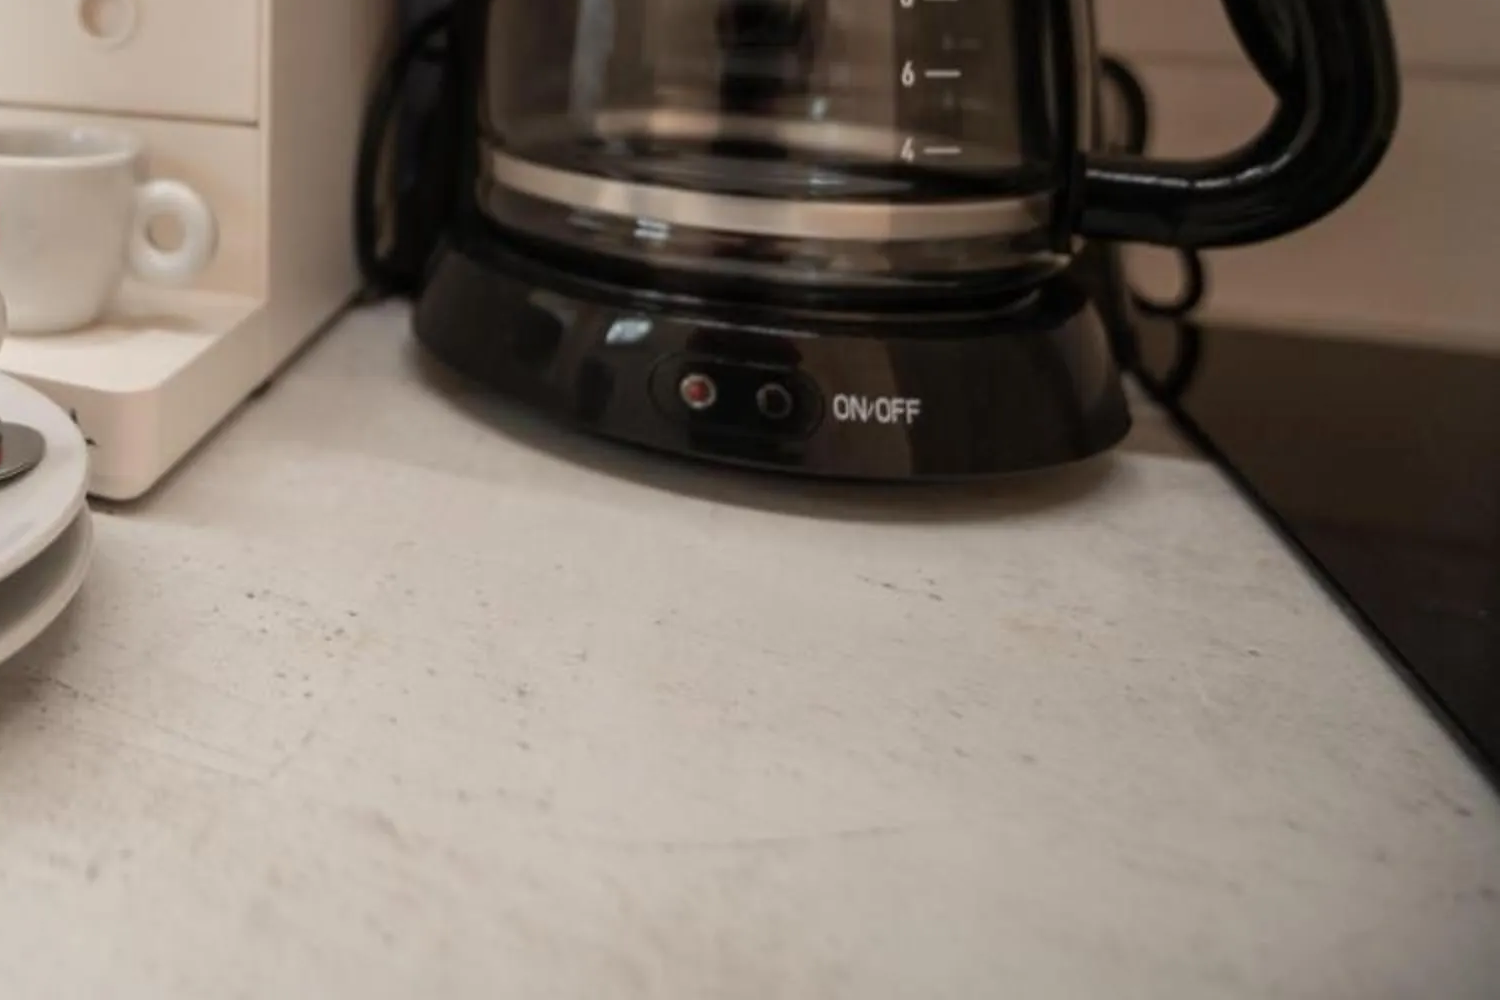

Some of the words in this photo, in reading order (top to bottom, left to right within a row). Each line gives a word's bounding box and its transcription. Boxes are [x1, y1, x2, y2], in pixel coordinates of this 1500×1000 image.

[901, 61, 915, 87] 6
[901, 137, 915, 162] 4
[833, 393, 921, 424] ON/OFF
